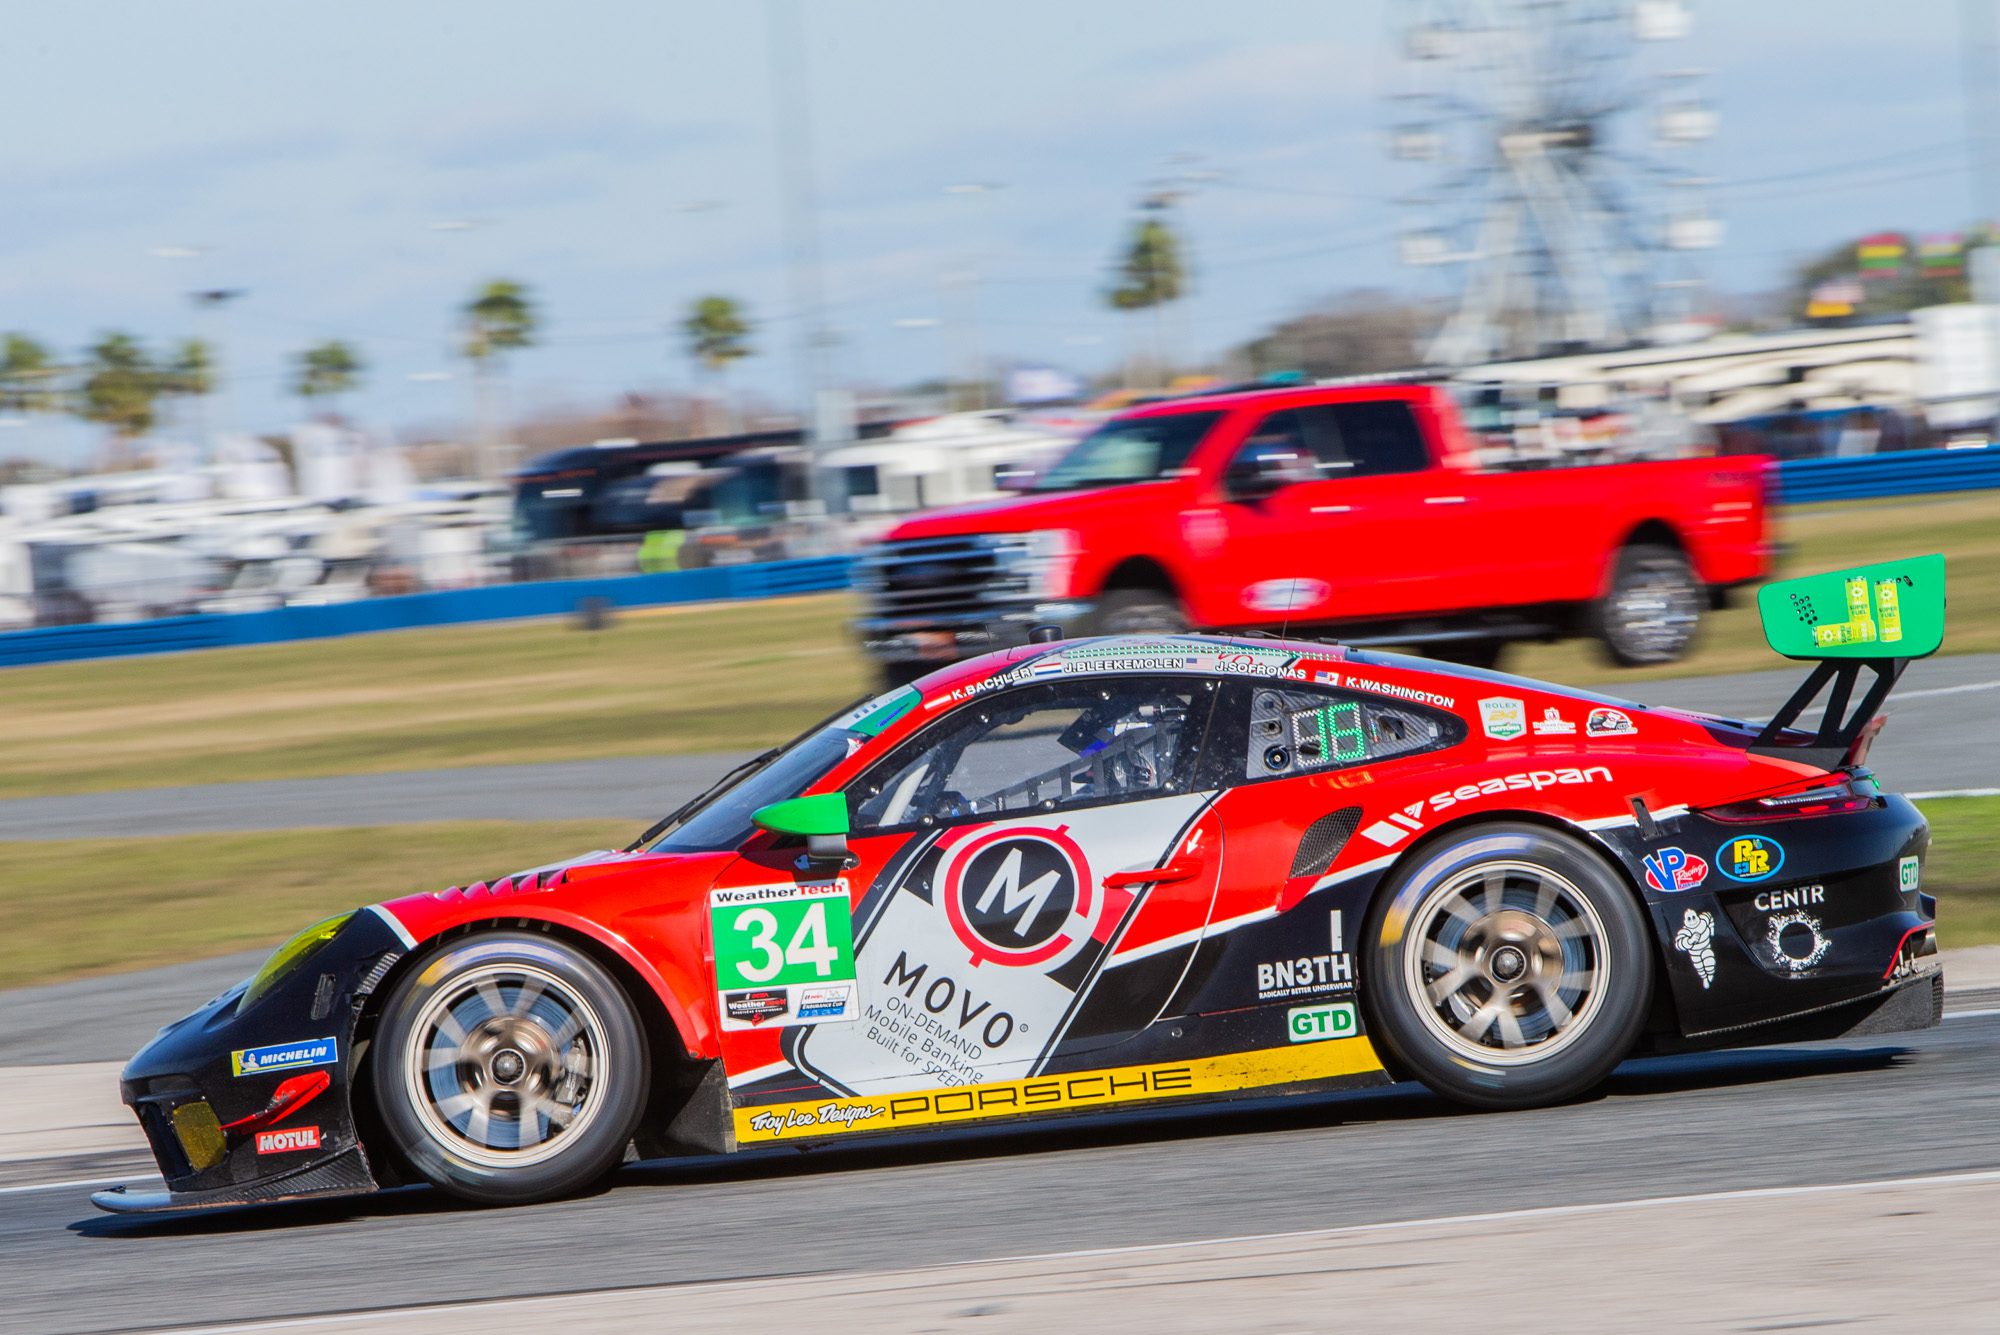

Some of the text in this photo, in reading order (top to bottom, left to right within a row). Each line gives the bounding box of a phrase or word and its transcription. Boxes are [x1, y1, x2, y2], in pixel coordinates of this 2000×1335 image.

[1063, 658, 1184, 674] J.BLEEKEMOLEN
[1214, 661, 1307, 679] J.SOFRONAS
[952, 668, 1032, 700] K.BACHLER
[1346, 676, 1455, 708] K.WASHINGTON
[1429, 766, 1613, 811] seaspan
[1642, 847, 1687, 891] VP
[1676, 864, 1706, 881] Racing
[1901, 861, 1918, 884] GTD
[1755, 884, 1825, 911] CENTR
[734, 902, 838, 982] 34
[1257, 953, 1352, 991] BN3TH
[883, 950, 1014, 1048] MOVO
[1258, 982, 1353, 999] RADICALLY BETTER UNDERWEAR
[886, 997, 982, 1060] ON-DEMAND
[1292, 1009, 1351, 1035] GTD
[260, 1046, 327, 1065] MICHELIN
[865, 1004, 984, 1085] Mobile Banking
[867, 1026, 899, 1053] Built
[900, 1046, 922, 1065] for
[890, 1067, 1193, 1120] PORSCHE
[750, 1103, 885, 1136] Troy Lee Designs
[259, 1129, 317, 1151] MOTUL
